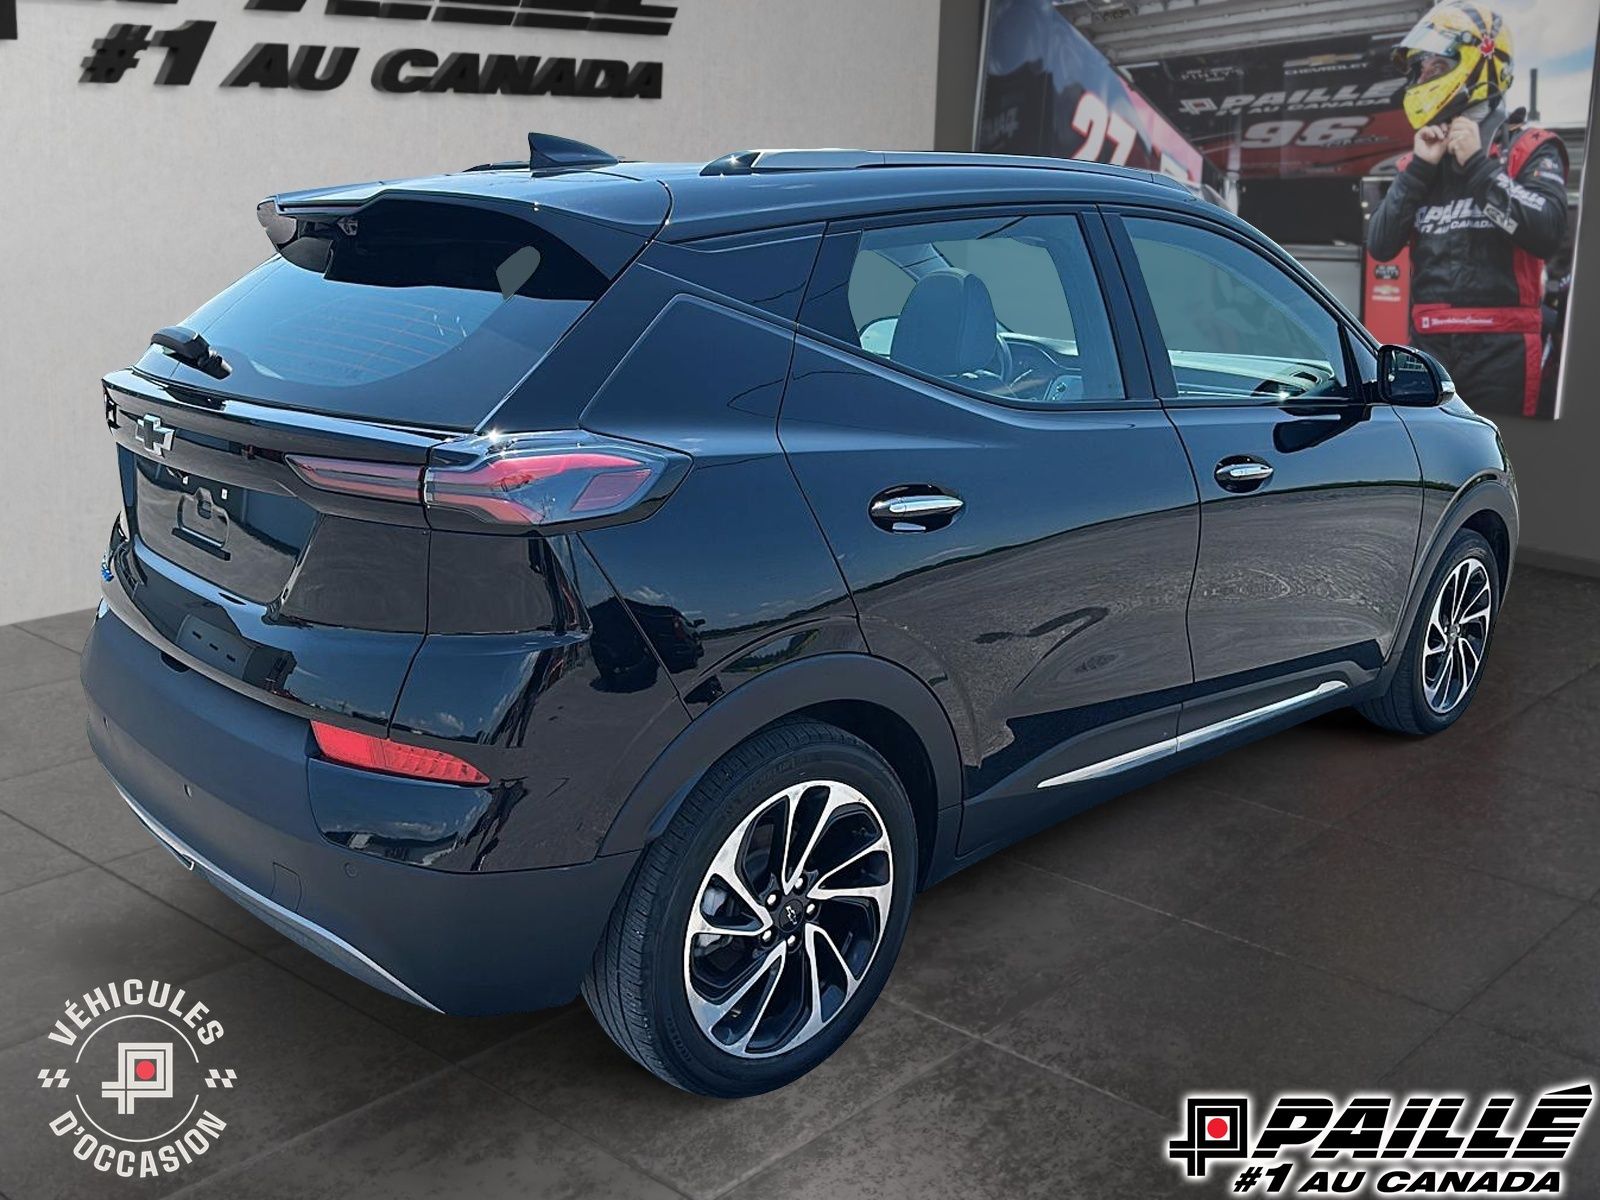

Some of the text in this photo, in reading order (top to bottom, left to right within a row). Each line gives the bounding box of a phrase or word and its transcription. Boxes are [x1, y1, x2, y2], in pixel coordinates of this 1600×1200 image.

[78, 20, 663, 99] #1 AU CANADA
[1284, 62, 1368, 76] CHEVROLET
[1287, 97, 1391, 113] CANADA
[1071, 91, 1137, 167] 27
[1241, 116, 1369, 149] 96
